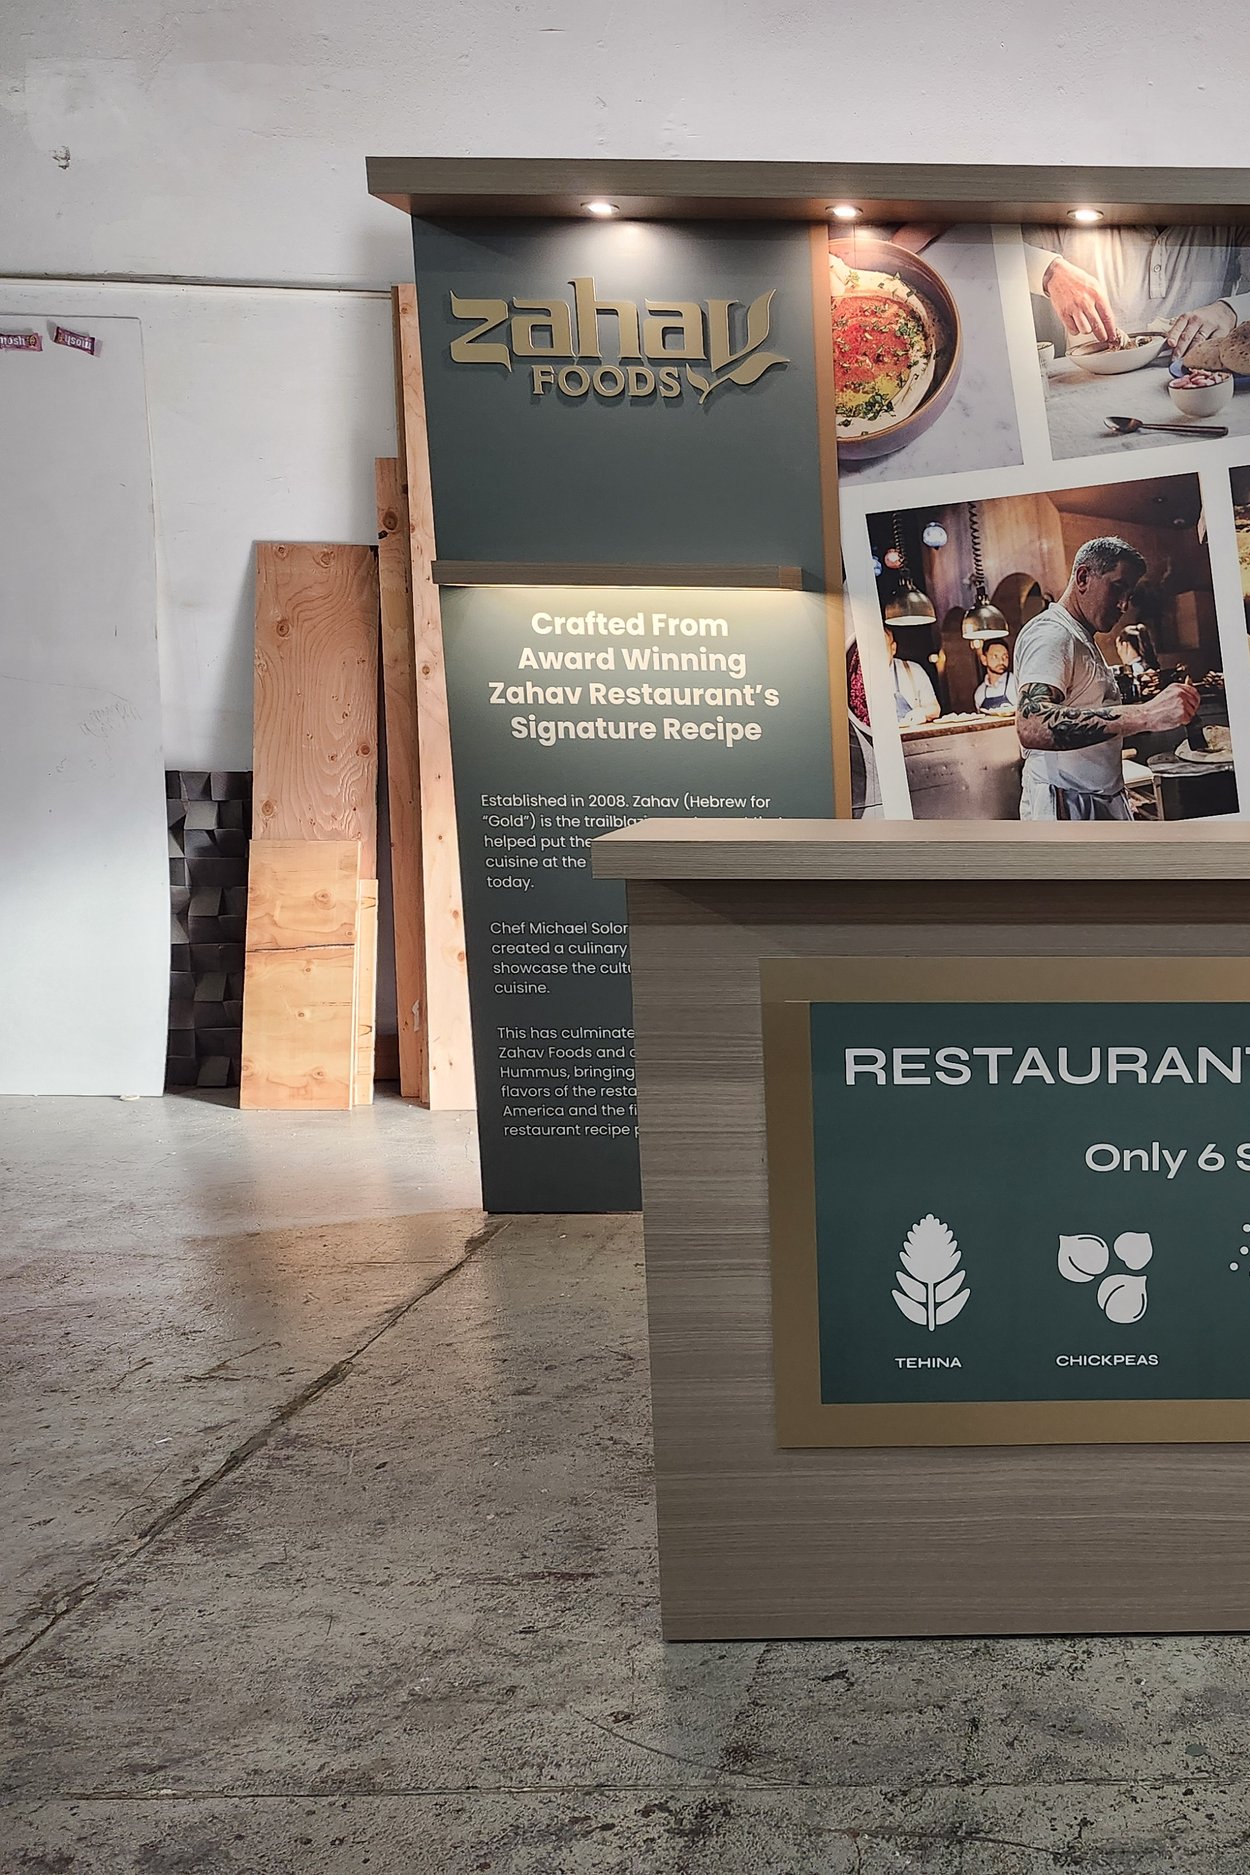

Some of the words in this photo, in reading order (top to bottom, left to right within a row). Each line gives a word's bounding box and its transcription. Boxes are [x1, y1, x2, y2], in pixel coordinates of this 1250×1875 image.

[450, 277, 790, 374] zahav
[532, 365, 681, 398] FOODS
[532, 611, 644, 635] Crafted
[652, 614, 728, 636] From
[519, 647, 615, 670] Award
[621, 646, 746, 678] Winning
[489, 681, 582, 704] Zahav
[589, 683, 779, 706] Restaurant’s
[512, 715, 656, 746] Signature
[664, 716, 761, 747] Recipe
[482, 794, 566, 806] Established
[571, 795, 584, 806] in
[589, 795, 629, 807] 2008.
[633, 795, 679, 807] Zahav
[684, 793, 746, 810] (Hebrew
[751, 796, 770, 808] for
[483, 812, 535, 829] “Gold”)
[541, 815, 551, 827] is
[556, 815, 580, 827] the
[485, 835, 536, 850] helped
[541, 836, 566, 850] put
[570, 835, 591, 847] the
[486, 855, 538, 867] cuisine
[543, 857, 558, 867] at
[562, 856, 586, 867] the
[487, 876, 534, 891] today.
[491, 922, 525, 933] Chef
[530, 922, 587, 933] Michael
[492, 942, 550, 953] created
[555, 945, 563, 953] a
[569, 942, 627, 957] culinary
[494, 962, 568, 973] showcase
[572, 962, 596, 973] the
[495, 982, 549, 993] cuisine.
[498, 1027, 526, 1038] This
[531, 1027, 557, 1038] has
[499, 1047, 544, 1058] Zahav
[549, 1047, 592, 1058] Foods
[597, 1047, 624, 1057] and
[501, 1067, 570, 1079] Hummus,
[574, 1066, 635, 1081] bringing
[502, 1085, 550, 1097] flavors
[555, 1085, 568, 1096] of
[573, 1086, 596, 1096] the
[503, 1105, 564, 1116] America
[569, 1105, 597, 1115] and
[602, 1105, 625, 1115] the
[505, 1125, 580, 1135] restaurant
[585, 1124, 630, 1138] recipe
[1086, 1142, 1187, 1178] Only
[1198, 1144, 1224, 1171] 6
[895, 1357, 961, 1368] TEHINA
[1057, 1355, 1158, 1366] CHICKPEAS
